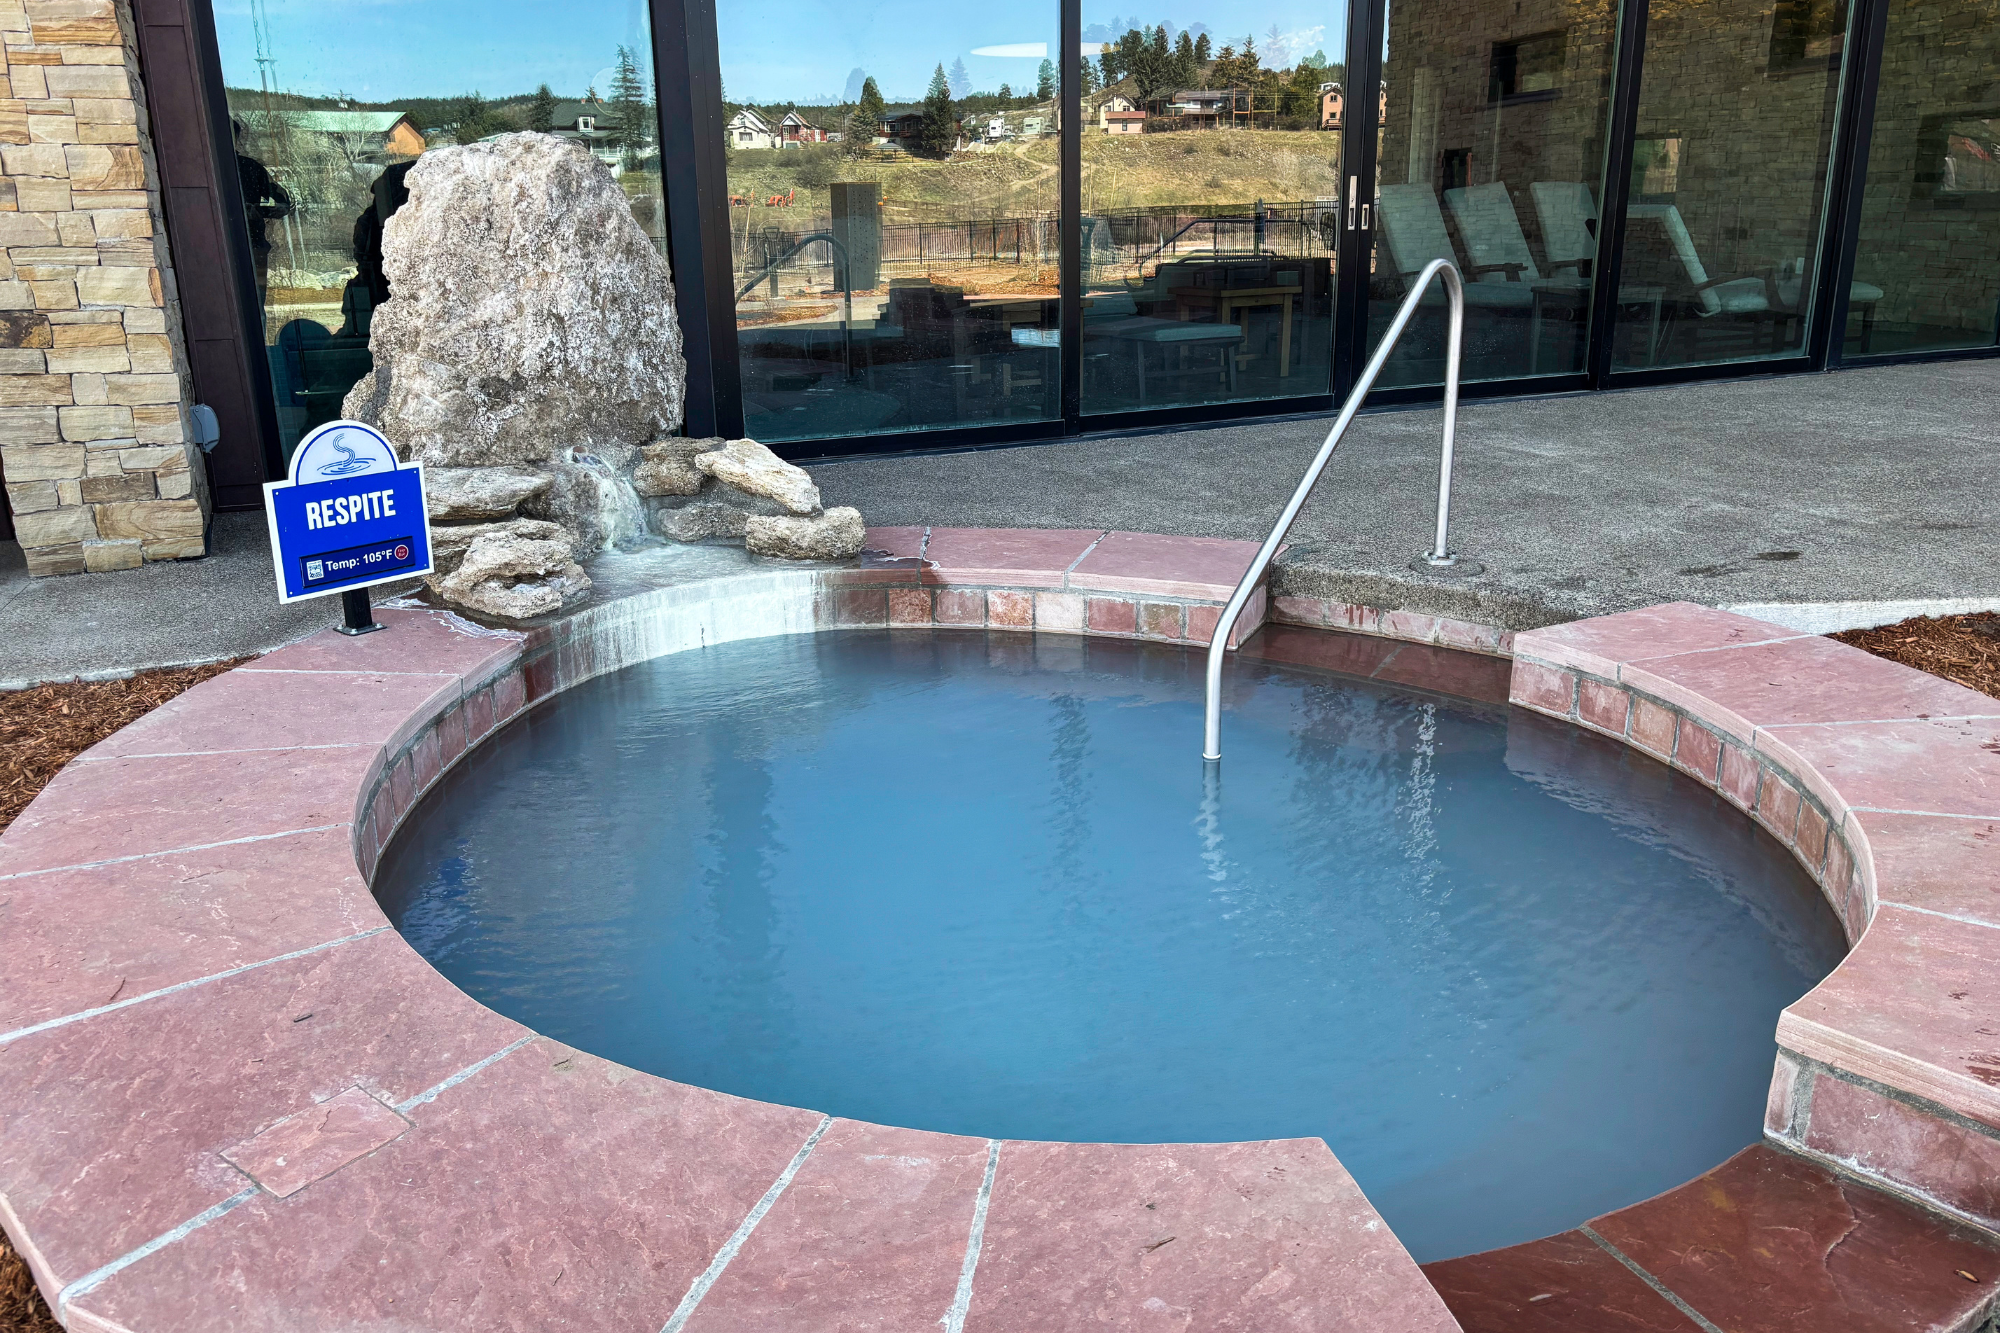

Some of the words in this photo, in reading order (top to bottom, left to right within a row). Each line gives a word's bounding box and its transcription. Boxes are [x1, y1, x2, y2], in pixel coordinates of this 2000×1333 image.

[305, 489, 396, 530] RESPITE
[325, 558, 360, 571] Temp:
[363, 549, 393, 564] 105°F
